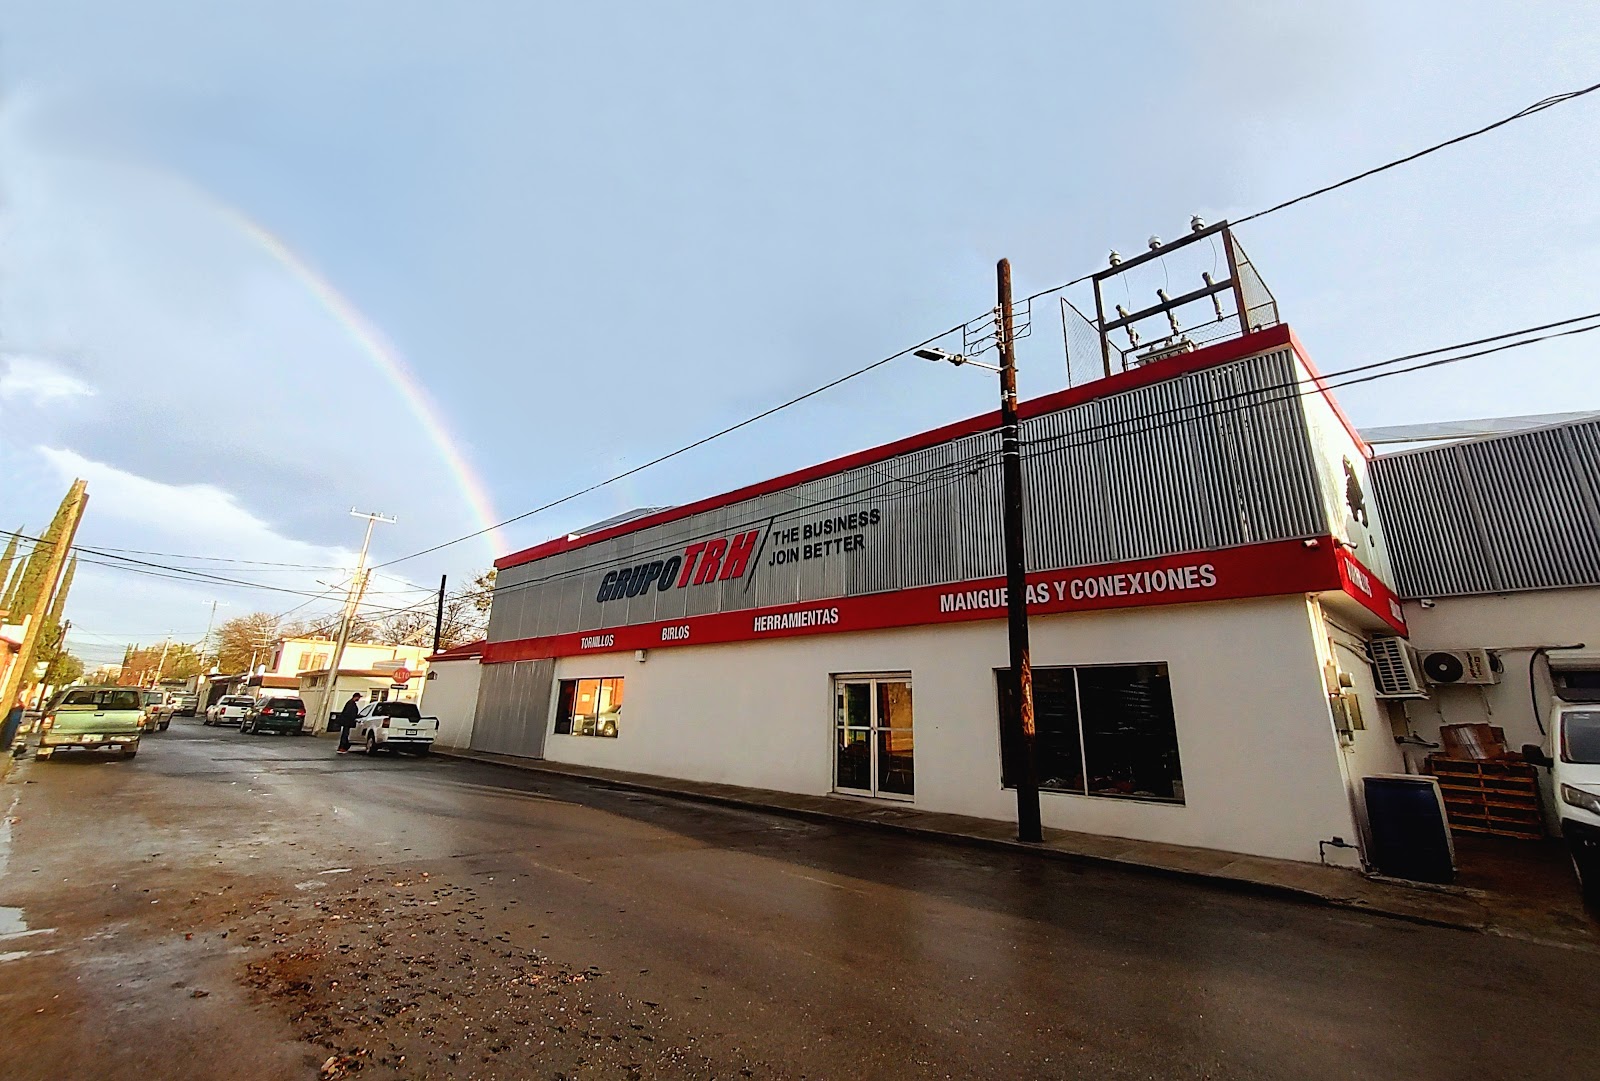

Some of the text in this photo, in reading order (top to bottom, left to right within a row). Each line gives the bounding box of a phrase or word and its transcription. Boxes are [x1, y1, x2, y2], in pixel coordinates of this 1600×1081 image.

[773, 508, 880, 546] THE BUSINESS
[769, 534, 865, 566] JOIN BETTER
[940, 564, 1217, 613] MANGUEAS Y CONEXIONES
[661, 625, 690, 641] BIRLOS
[754, 607, 839, 632] HERRAMIENTAS
[581, 634, 614, 649] TORNILLOS
